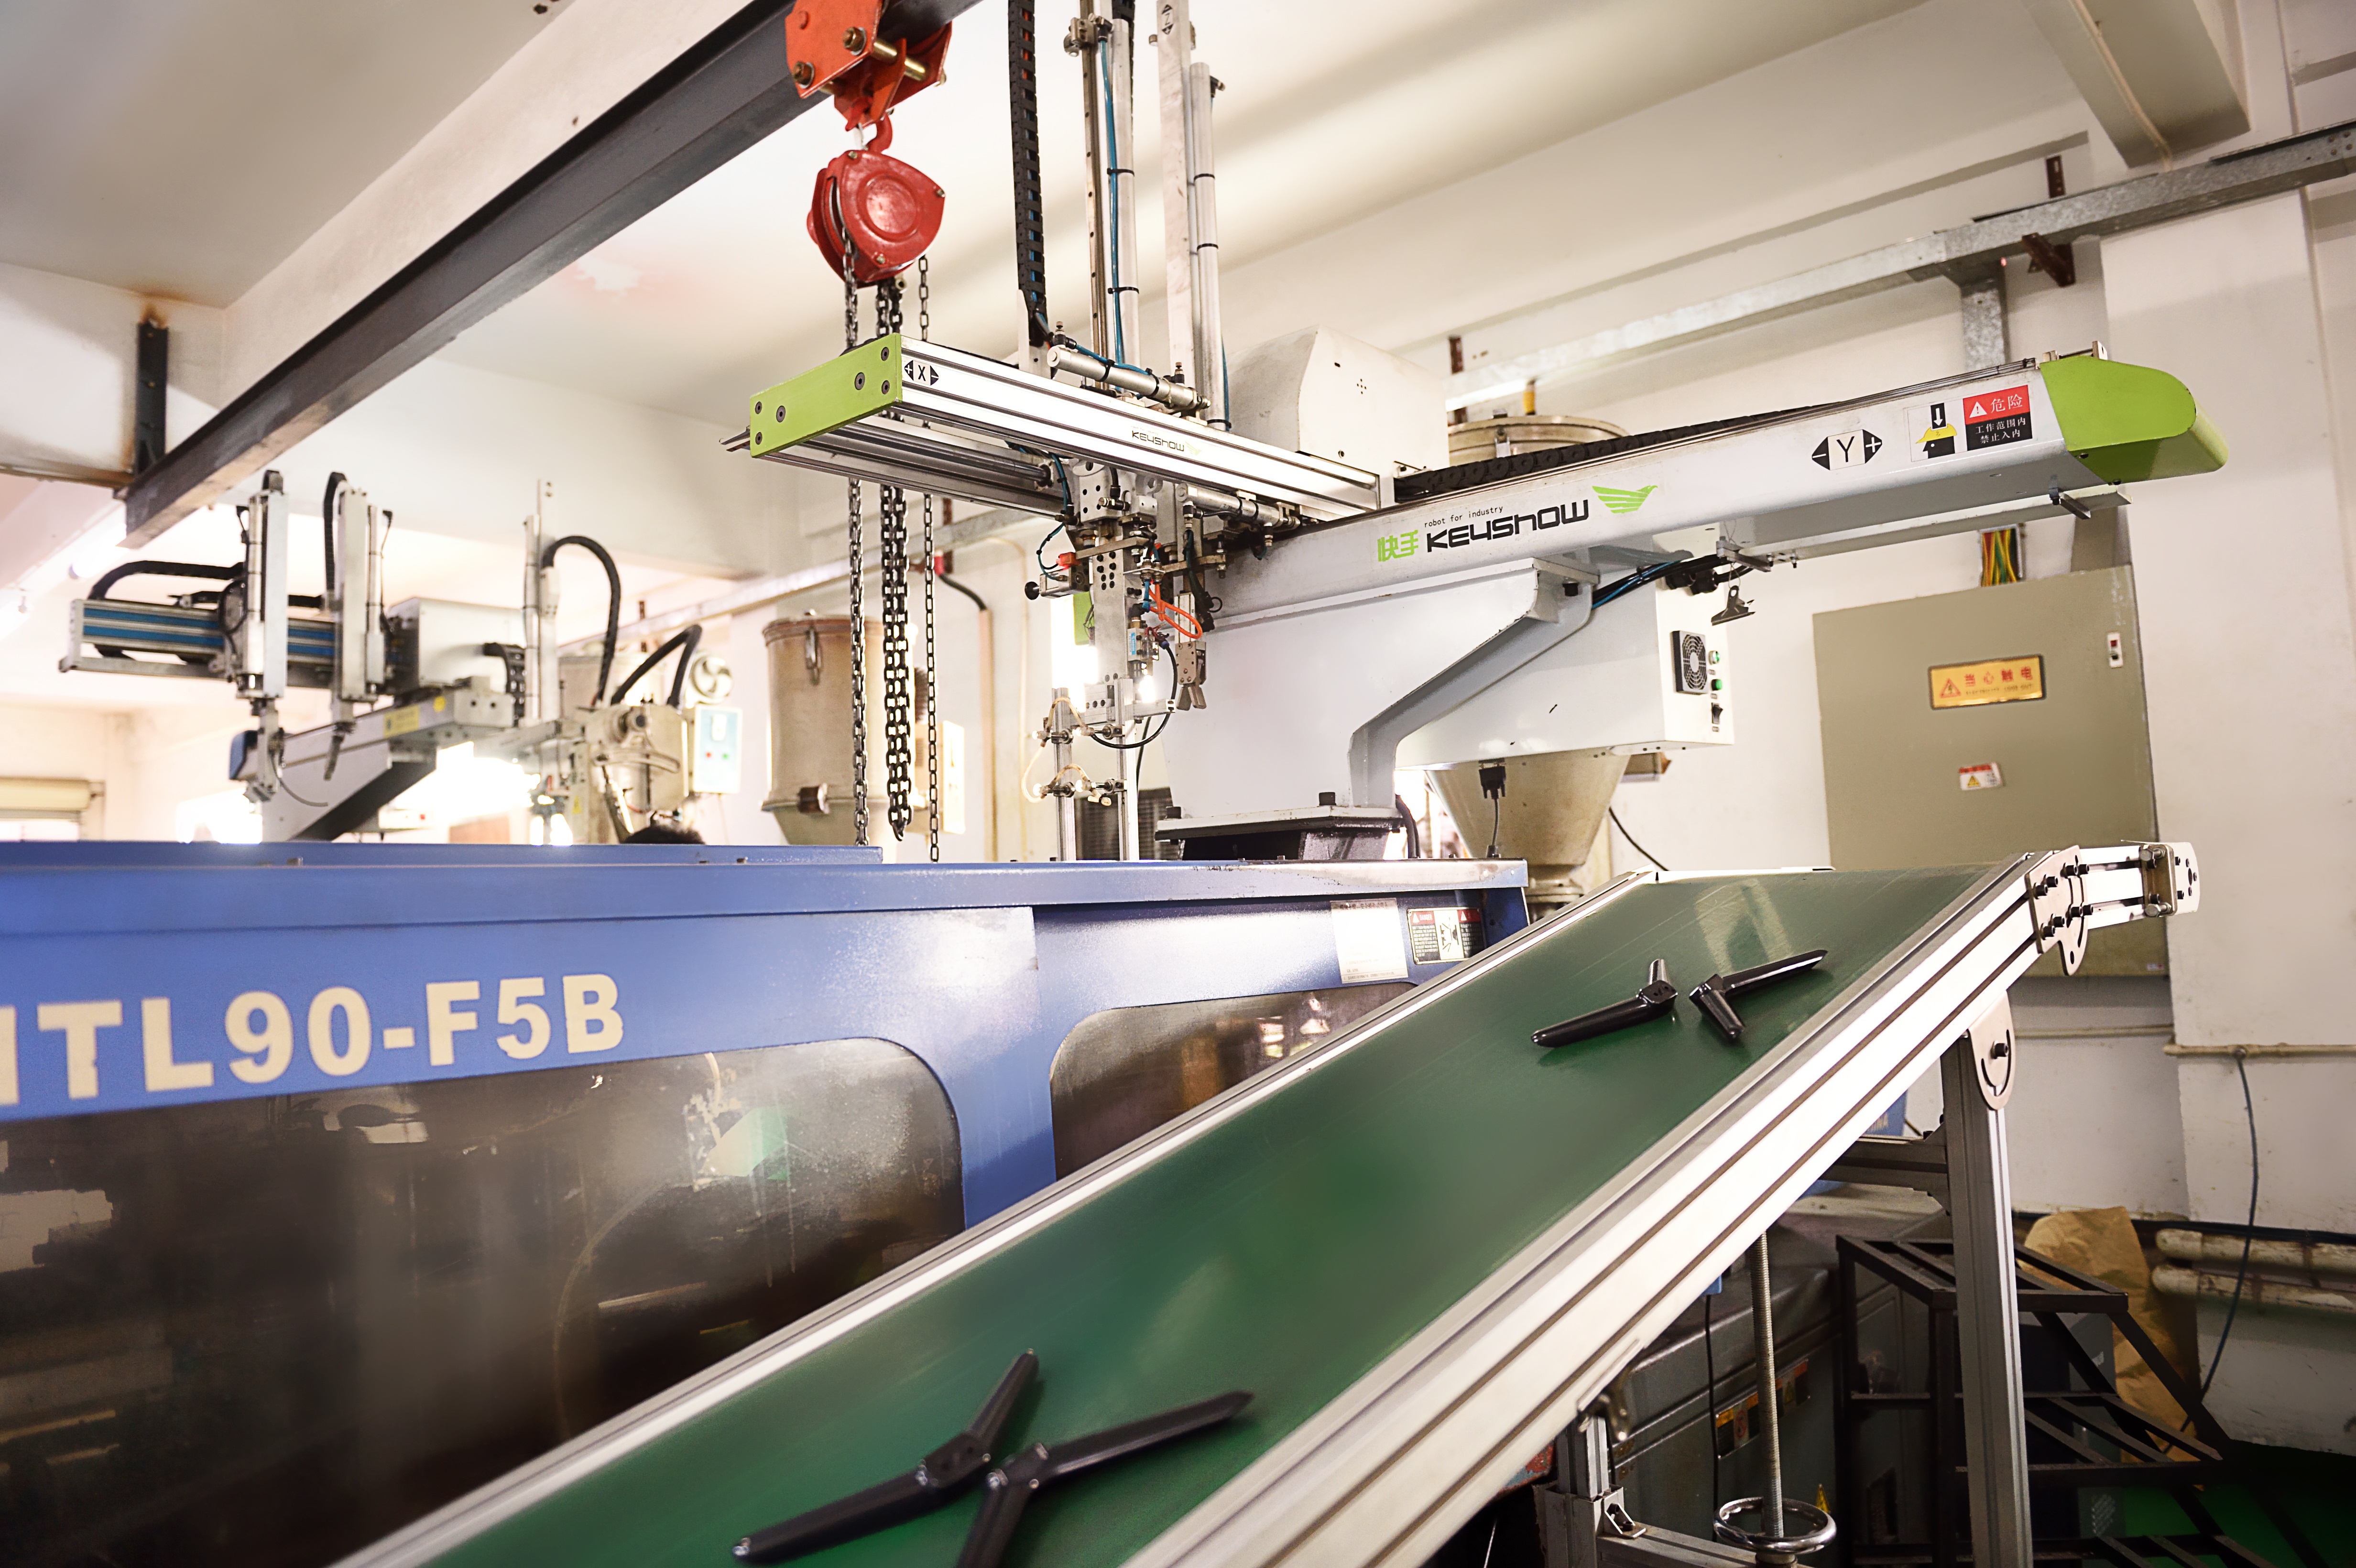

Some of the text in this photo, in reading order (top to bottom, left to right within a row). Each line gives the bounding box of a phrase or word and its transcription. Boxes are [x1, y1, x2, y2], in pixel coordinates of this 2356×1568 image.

[918, 365, 926, 381] X
[1990, 393, 2023, 414] 危险
[1975, 417, 2026, 434] 工作范围内
[1980, 429, 2020, 444] 禁止入内
[1836, 436, 1855, 463] Y
[1424, 518, 1446, 528] robot
[1469, 506, 1503, 518] industry
[1377, 530, 1419, 562] 快手
[1964, 666, 2033, 687] 当心触电
